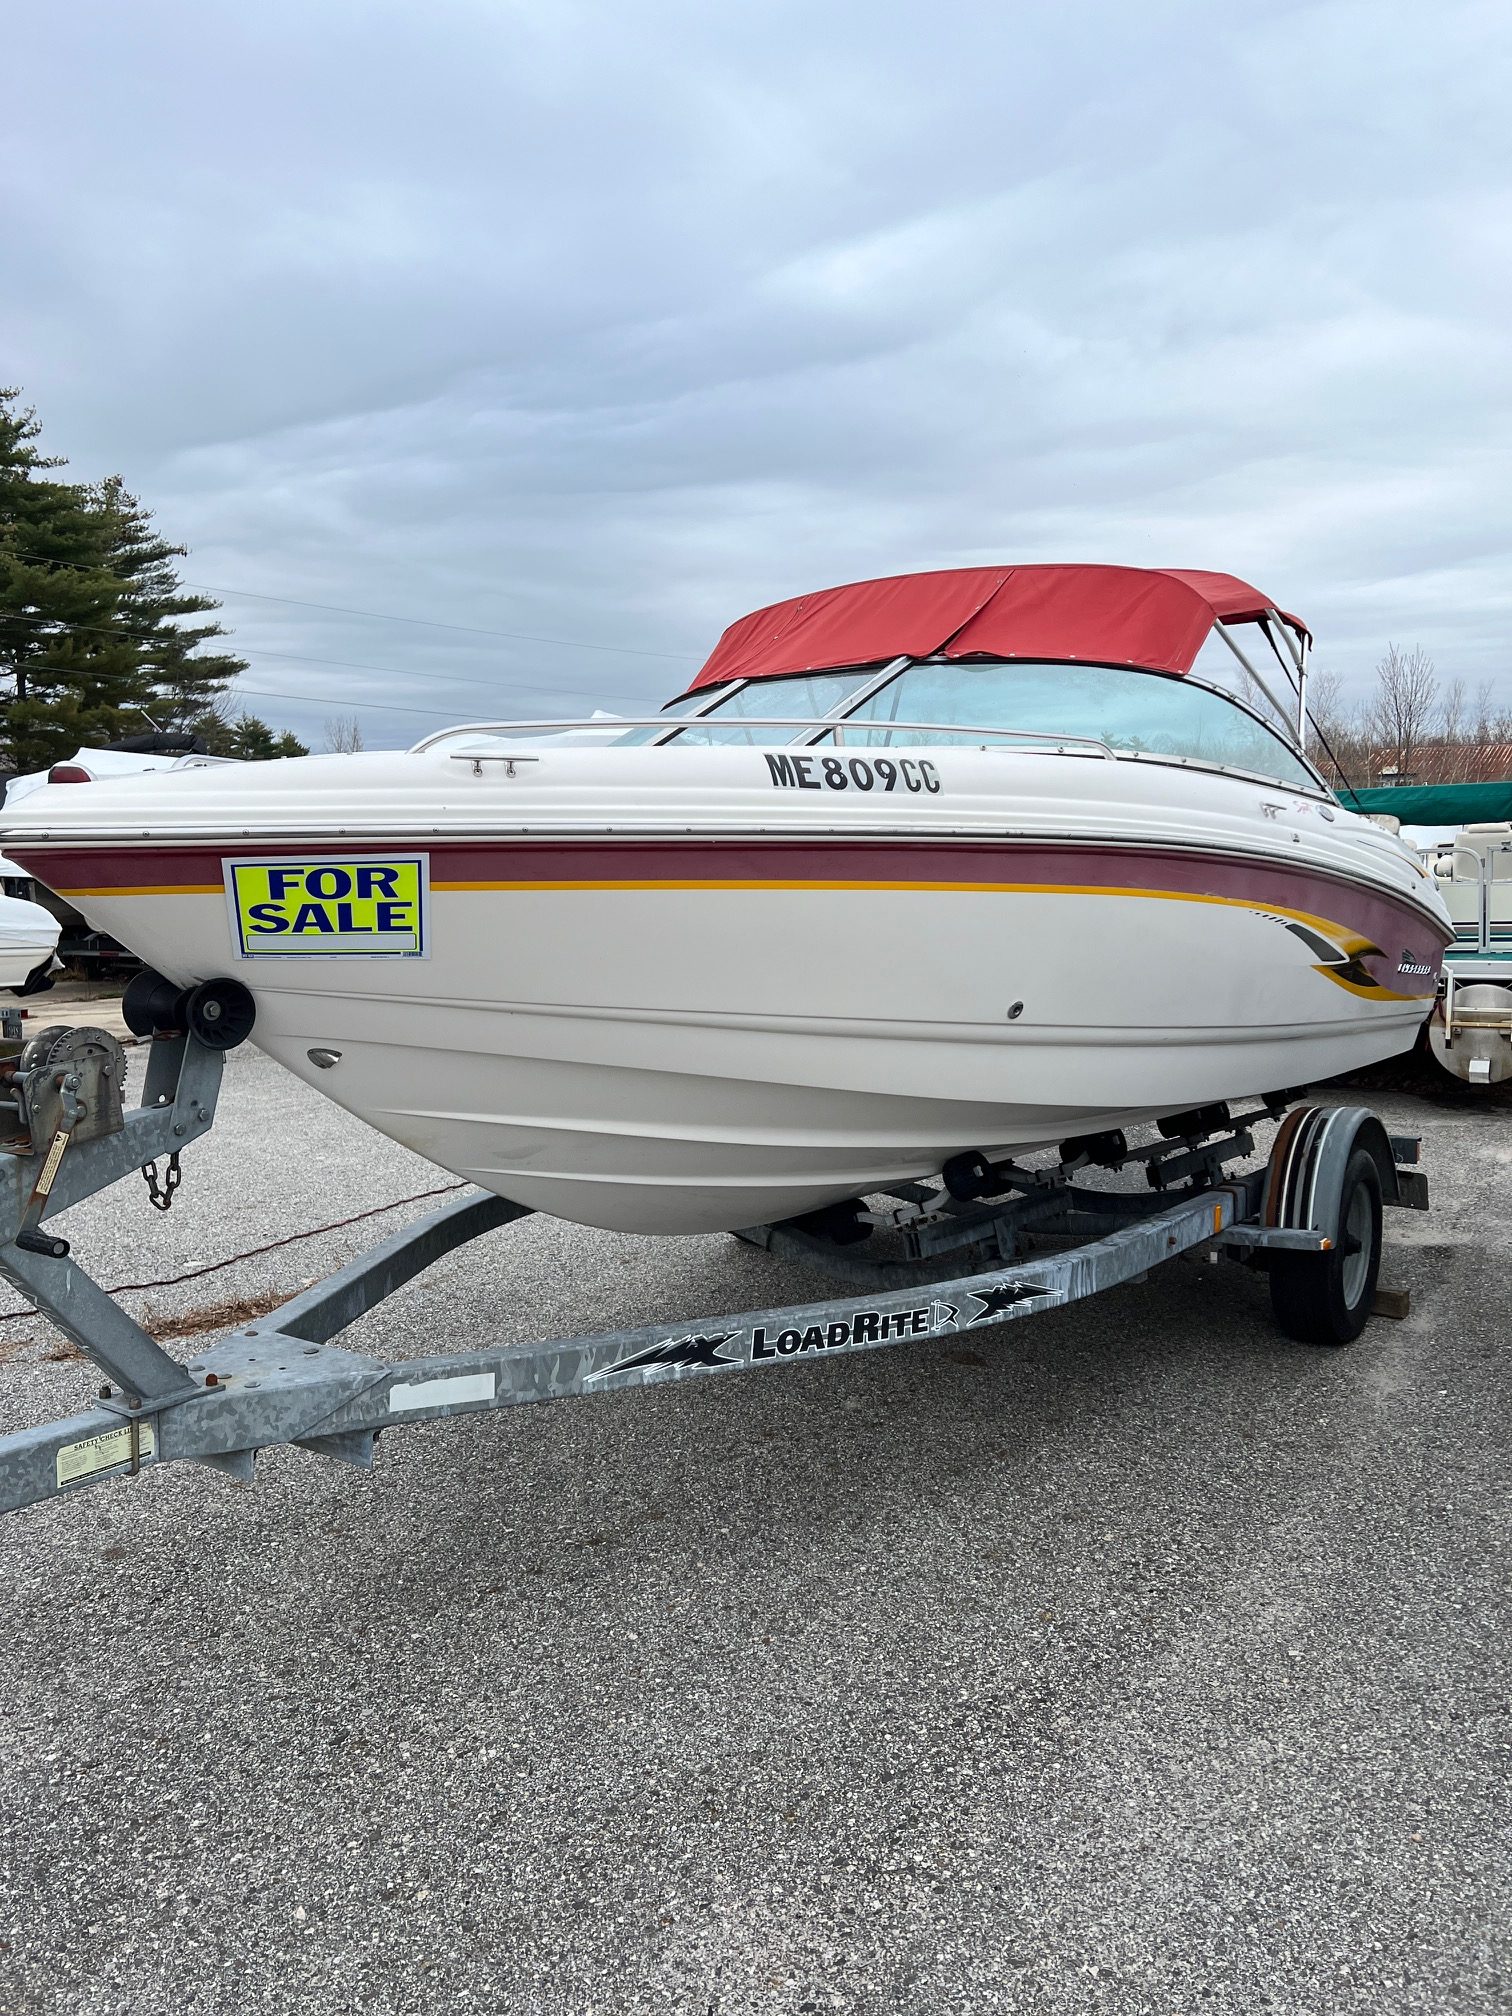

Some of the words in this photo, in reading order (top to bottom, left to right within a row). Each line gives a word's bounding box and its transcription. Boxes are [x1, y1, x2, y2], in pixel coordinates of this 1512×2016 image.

[268, 867, 399, 900] FOR
[248, 902, 413, 933] SALE
[74, 1438, 99, 1451] SAFETY
[99, 1431, 123, 1443] CHECK
